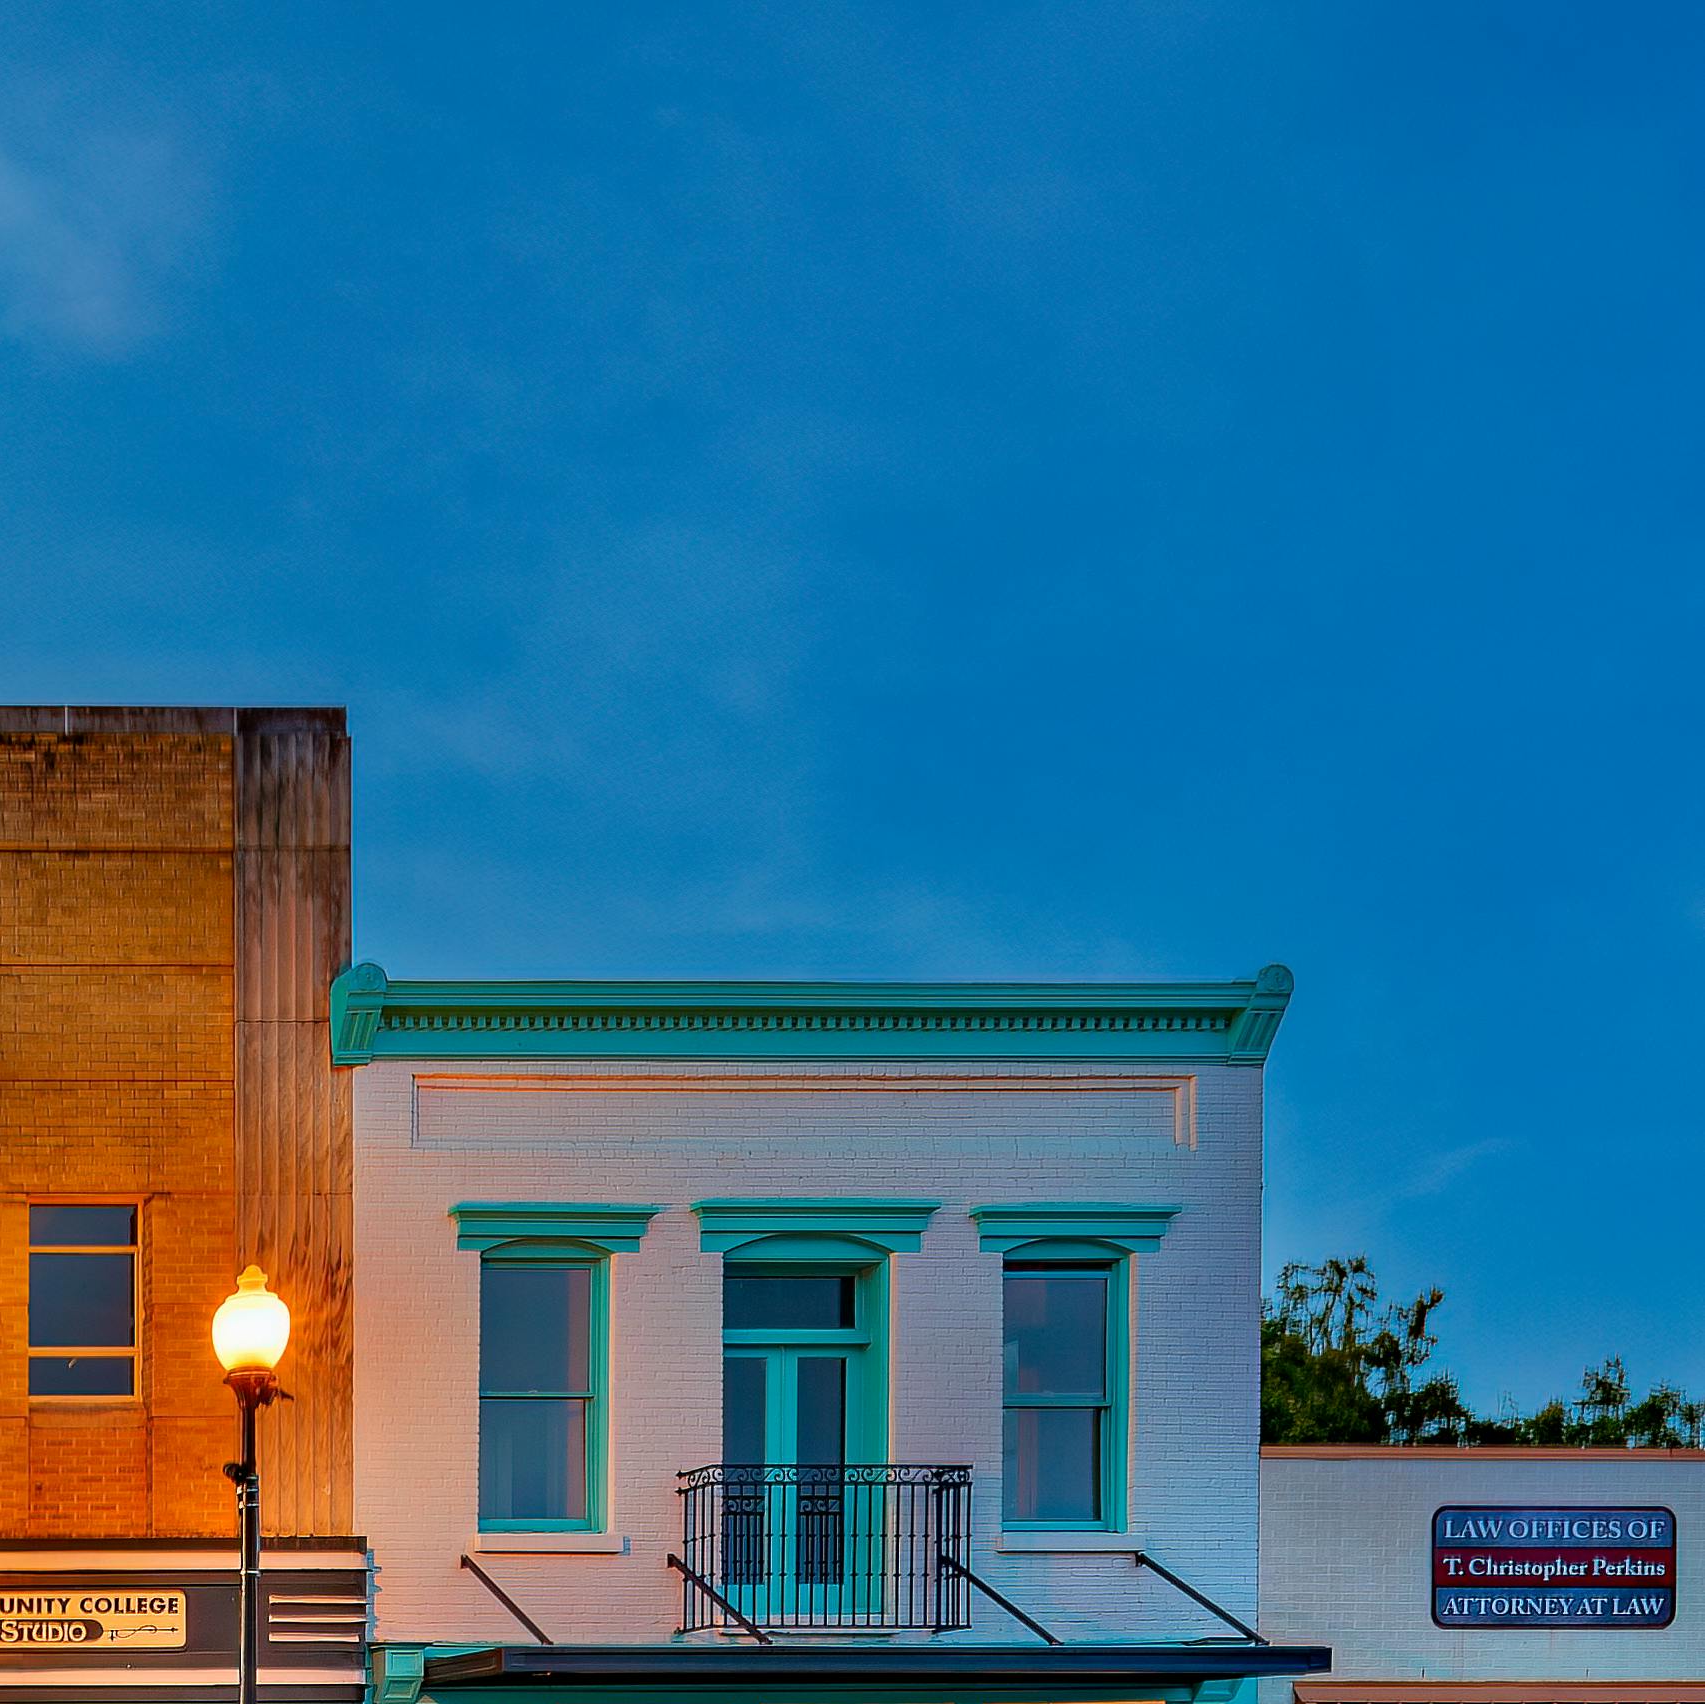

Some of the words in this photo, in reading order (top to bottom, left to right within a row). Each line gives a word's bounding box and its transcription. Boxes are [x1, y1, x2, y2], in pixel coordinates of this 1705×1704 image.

[1444, 1520, 1503, 1539] LAW
[1508, 1520, 1622, 1539] OFFICES
[1627, 1520, 1665, 1539] OF
[1443, 1557, 1464, 1576] T.
[1468, 1555, 1588, 1581] Christopher
[1592, 1556, 1666, 1576] Perkins
[79, 1597, 179, 1615] COLLEGE
[1442, 1597, 1576, 1616] ATTORNEY
[1576, 1597, 1608, 1616] AT
[1612, 1597, 1664, 1616] LAW
[0, 1619, 88, 1643] STUDIO
